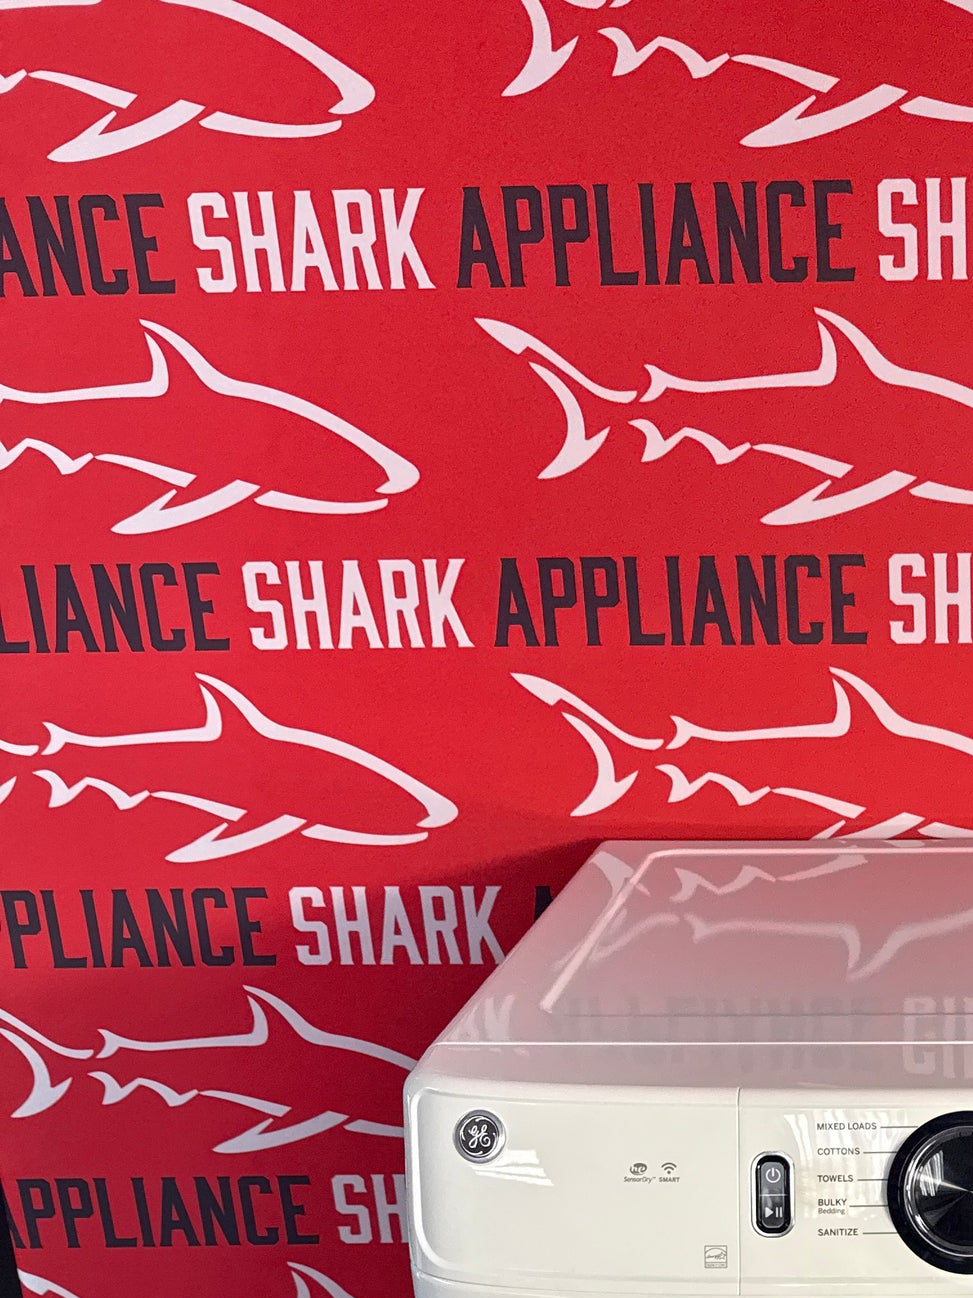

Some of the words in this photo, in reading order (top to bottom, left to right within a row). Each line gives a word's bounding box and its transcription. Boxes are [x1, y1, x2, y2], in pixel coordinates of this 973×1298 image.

[187, 188, 437, 293] SHARK
[456, 180, 857, 289] APPLIANCE
[242, 558, 475, 651] SHARK
[494, 554, 868, 647] APPLIANCE
[289, 886, 505, 965] SHARK
[816, 1122, 845, 1131] MIXED
[847, 1122, 877, 1131] LOADS
[817, 1147, 861, 1156] COTTONS
[817, 1174, 854, 1183] TOWELS
[817, 1198, 848, 1207] BULKY
[817, 1207, 846, 1216] Bedding
[817, 1228, 859, 1237] SANITIZE
